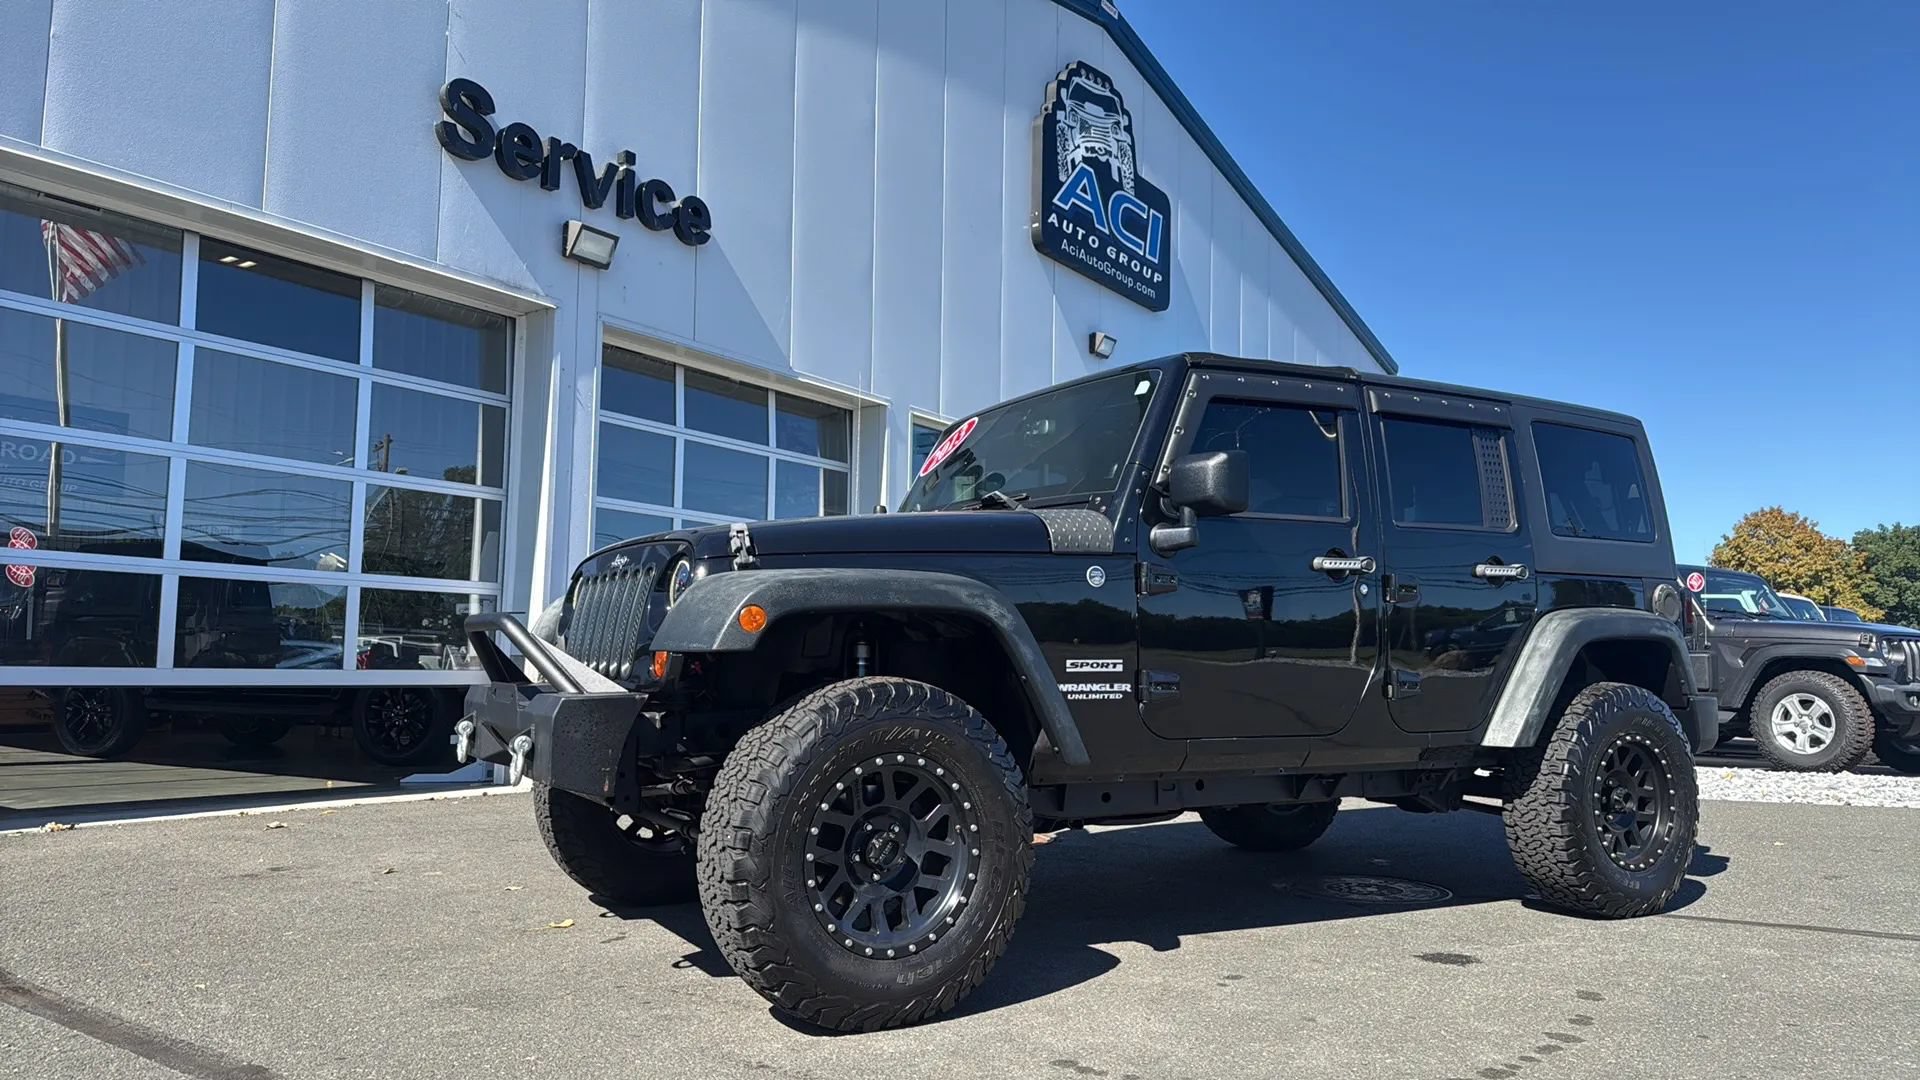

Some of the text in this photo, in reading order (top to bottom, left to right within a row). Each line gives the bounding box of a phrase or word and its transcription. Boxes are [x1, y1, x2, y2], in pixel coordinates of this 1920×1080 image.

[435, 78, 712, 246] Service
[1052, 162, 1162, 264] ACI
[1048, 213, 1162, 283] AUTO GROUP
[1061, 239, 1156, 299] AciAutoGroup.com
[1057, 683, 1132, 692] WRANGLER
[1067, 660, 1123, 671] SPORT
